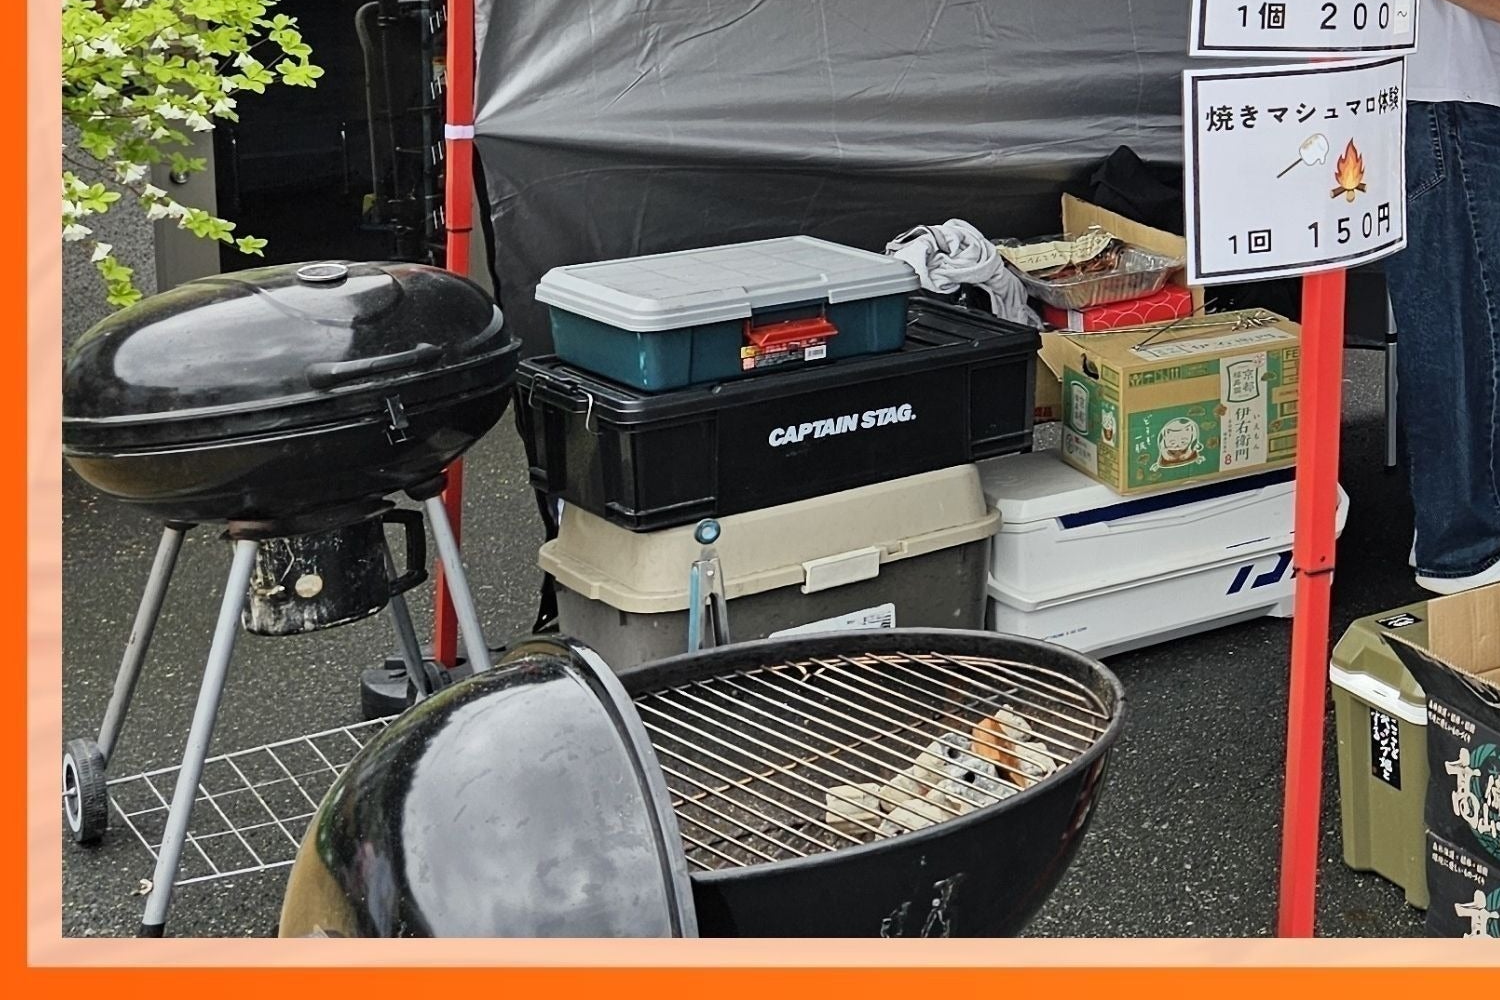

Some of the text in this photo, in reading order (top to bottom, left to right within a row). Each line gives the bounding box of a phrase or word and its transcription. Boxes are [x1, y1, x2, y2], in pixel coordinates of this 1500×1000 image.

[1237, 1, 1286, 29] 1個
[1206, 86, 1400, 132] 焼きマシュマロ体験
[1228, 202, 1390, 254] 1回 150円
[768, 414, 859, 447] CAPTAIN
[1235, 407, 1251, 461] 伊右衛門
